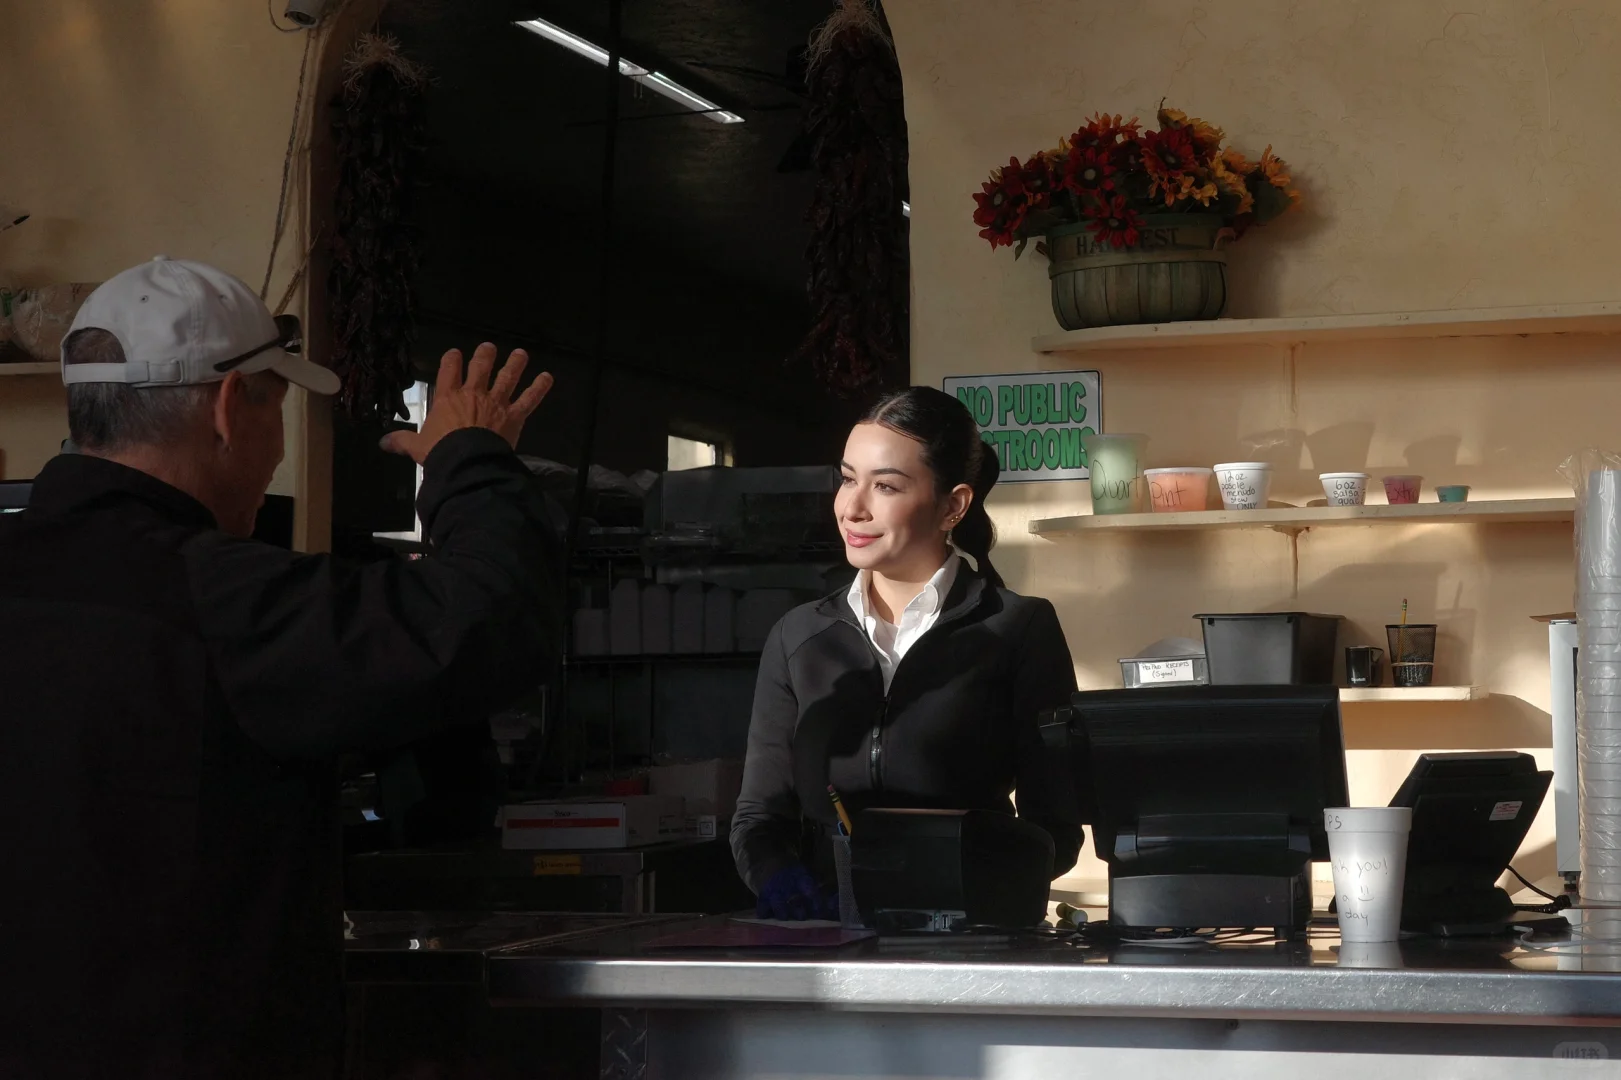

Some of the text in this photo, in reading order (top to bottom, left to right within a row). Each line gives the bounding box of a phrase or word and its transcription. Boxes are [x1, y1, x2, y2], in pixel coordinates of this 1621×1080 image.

[957, 381, 1087, 427] NO PUBLIC
[1091, 458, 1140, 501] Quart
[1224, 470, 1234, 483] 12
[1335, 480, 1343, 490] 6
[1150, 480, 1187, 508] Pint
[1227, 485, 1256, 496] menudo
[1333, 489, 1360, 499] salsa
[1356, 857, 1388, 878] you!
[1345, 907, 1369, 927] day
